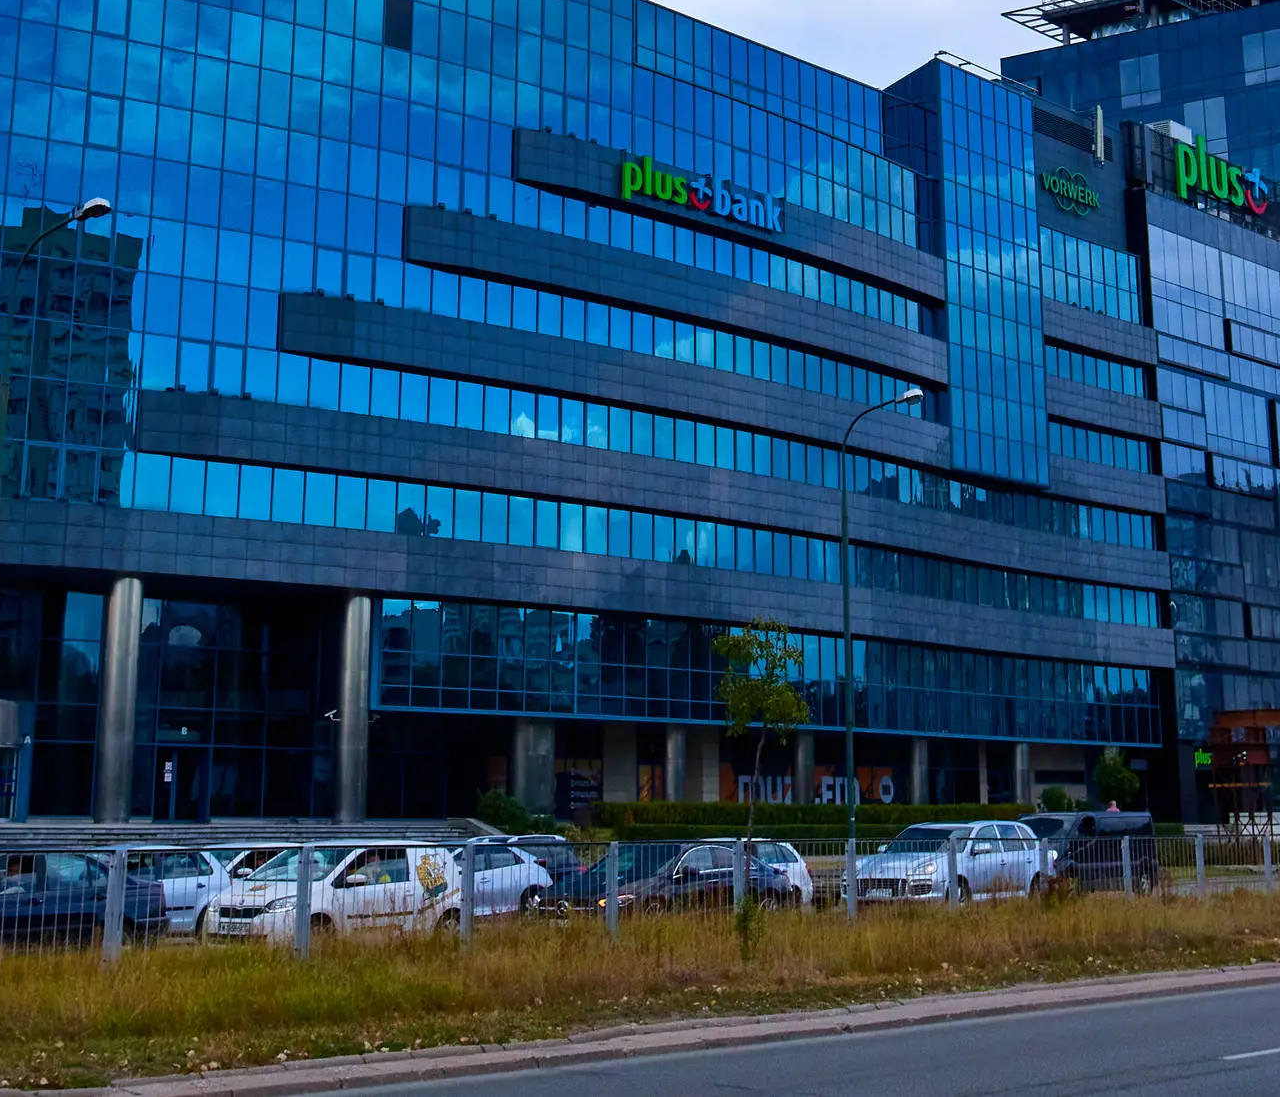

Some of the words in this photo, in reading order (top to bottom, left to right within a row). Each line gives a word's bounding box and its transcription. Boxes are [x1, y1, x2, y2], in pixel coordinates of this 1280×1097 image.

[1175, 134, 1245, 207] plus
[622, 156, 688, 205] plus
[713, 176, 782, 233] bank
[1040, 171, 1101, 210] VORWERK
[23, 735, 32, 744] A
[181, 726, 188, 735] B
[1194, 747, 1213, 769] plus
